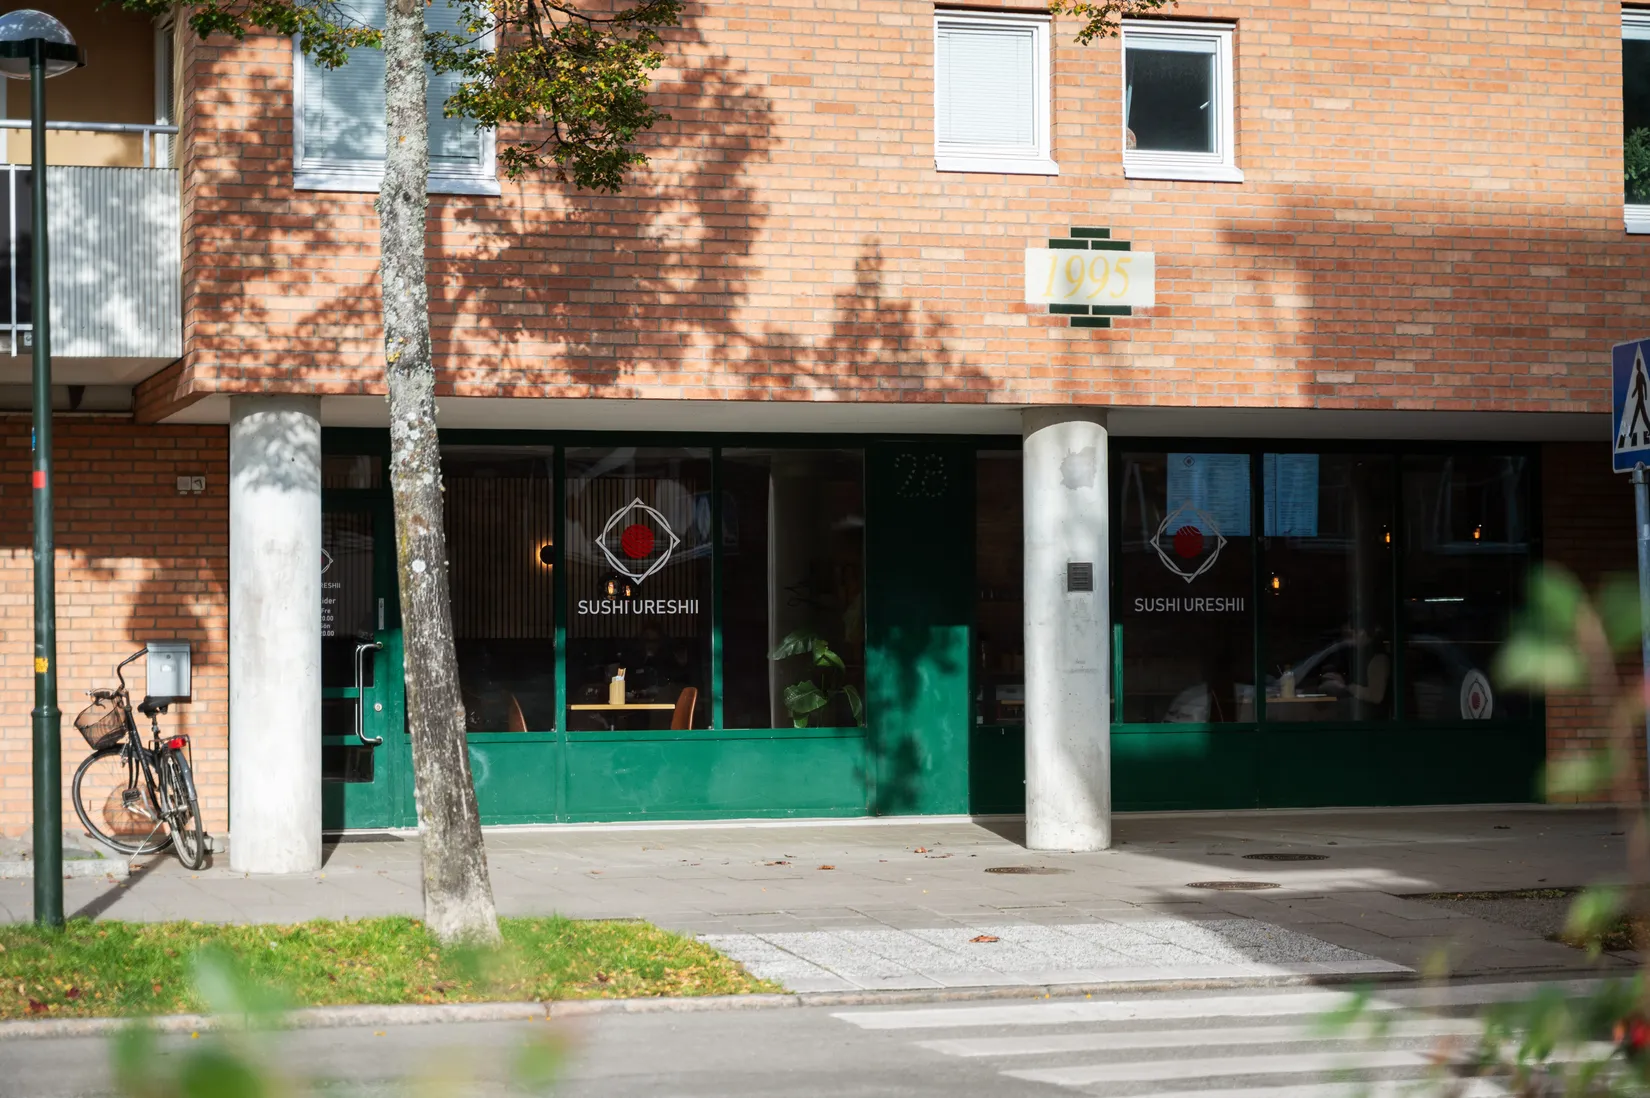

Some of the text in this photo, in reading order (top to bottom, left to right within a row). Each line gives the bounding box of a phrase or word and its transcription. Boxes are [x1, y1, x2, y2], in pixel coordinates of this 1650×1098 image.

[1042, 254, 1133, 299] 1995
[894, 453, 948, 498] 28
[578, 599, 699, 615] SUSHI URESHII
[1134, 597, 1244, 612] SUSHI URESHII
